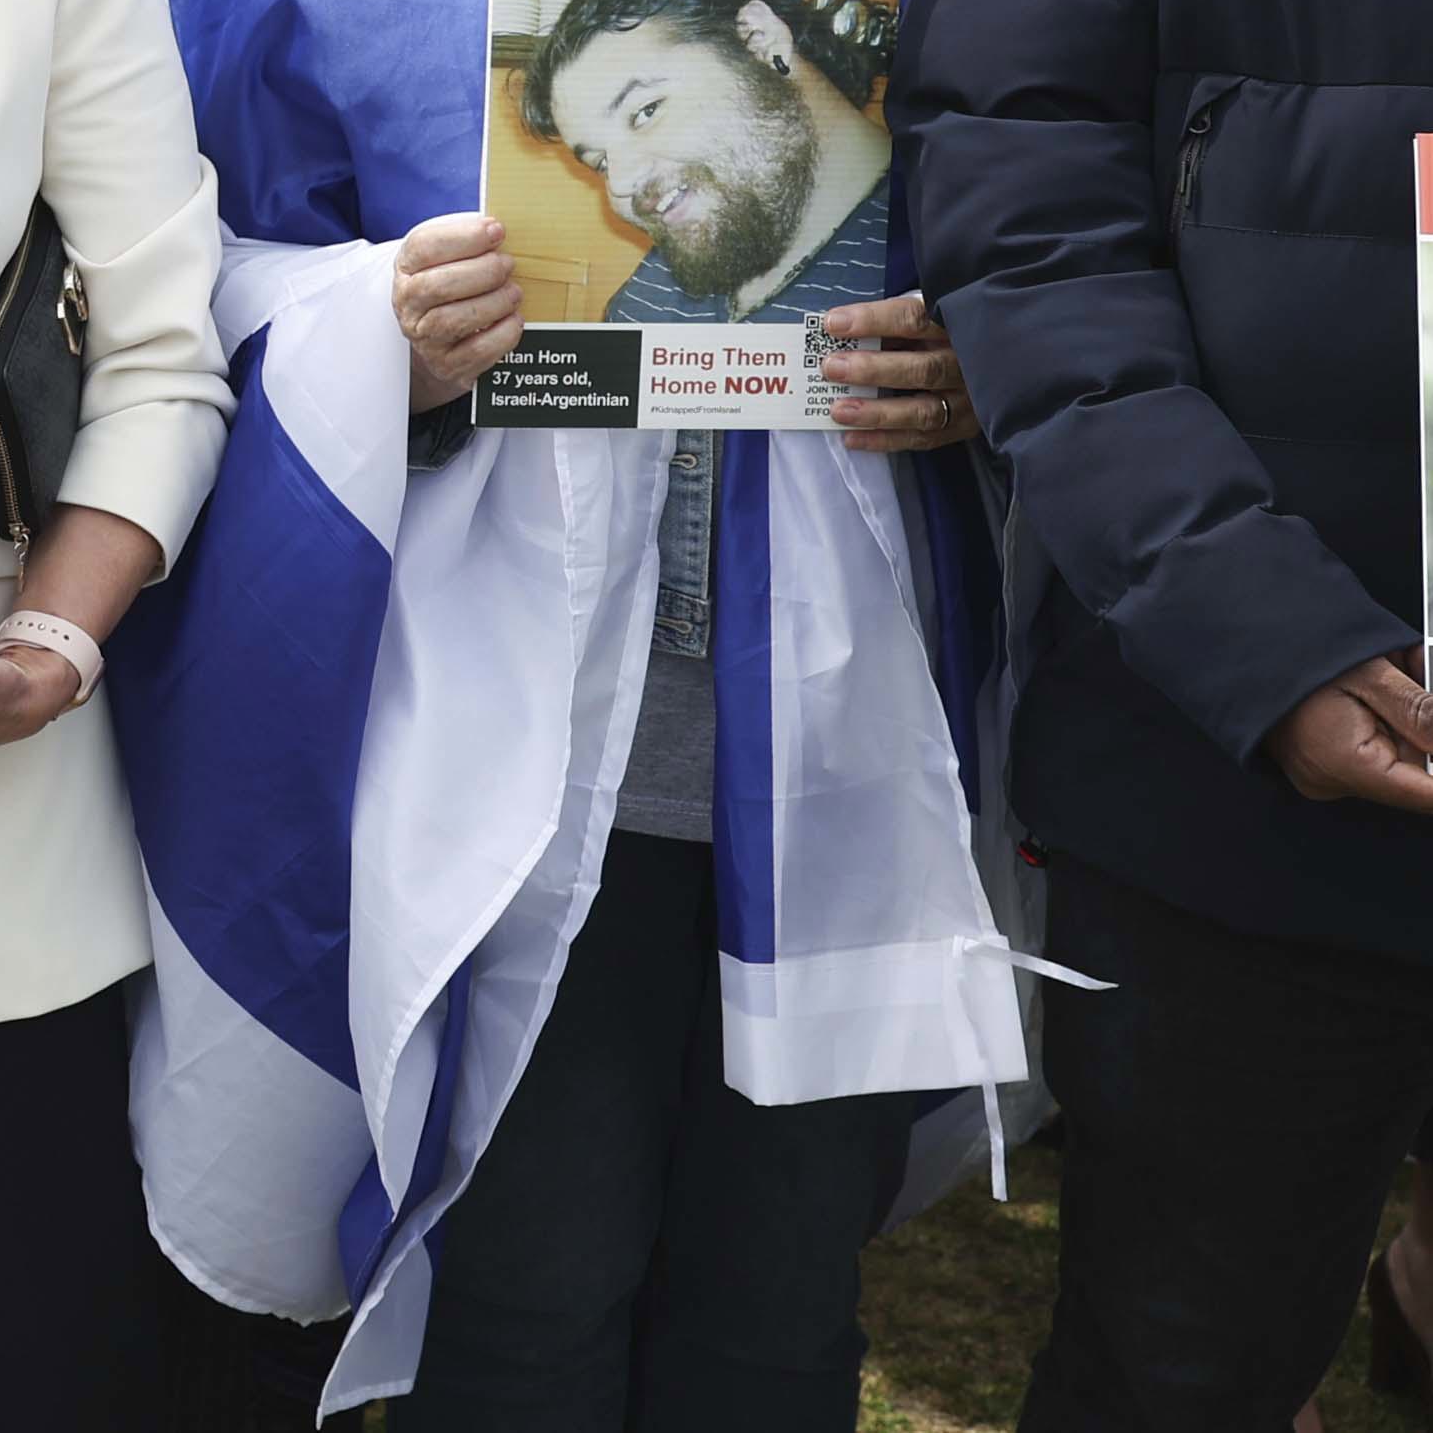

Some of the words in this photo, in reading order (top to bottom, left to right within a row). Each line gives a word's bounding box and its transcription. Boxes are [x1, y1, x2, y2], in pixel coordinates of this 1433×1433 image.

[496, 351, 534, 364] itan
[538, 350, 577, 364] Horn
[652, 347, 714, 370] Bring
[722, 347, 786, 366] Them
[492, 371, 511, 385] 37
[515, 374, 558, 388] years
[562, 371, 593, 387] old,
[807, 374, 829, 383] SCA
[650, 377, 717, 395] Home
[724, 377, 794, 395] NOW.
[806, 386, 830, 394] JOIN
[831, 386, 850, 394] THE
[491, 392, 630, 410] Israeli-Argentinian
[807, 396, 835, 405] GLOB
[650, 405, 742, 415] #KidnappedFromIsrael
[805, 408, 830, 416] EFFO
